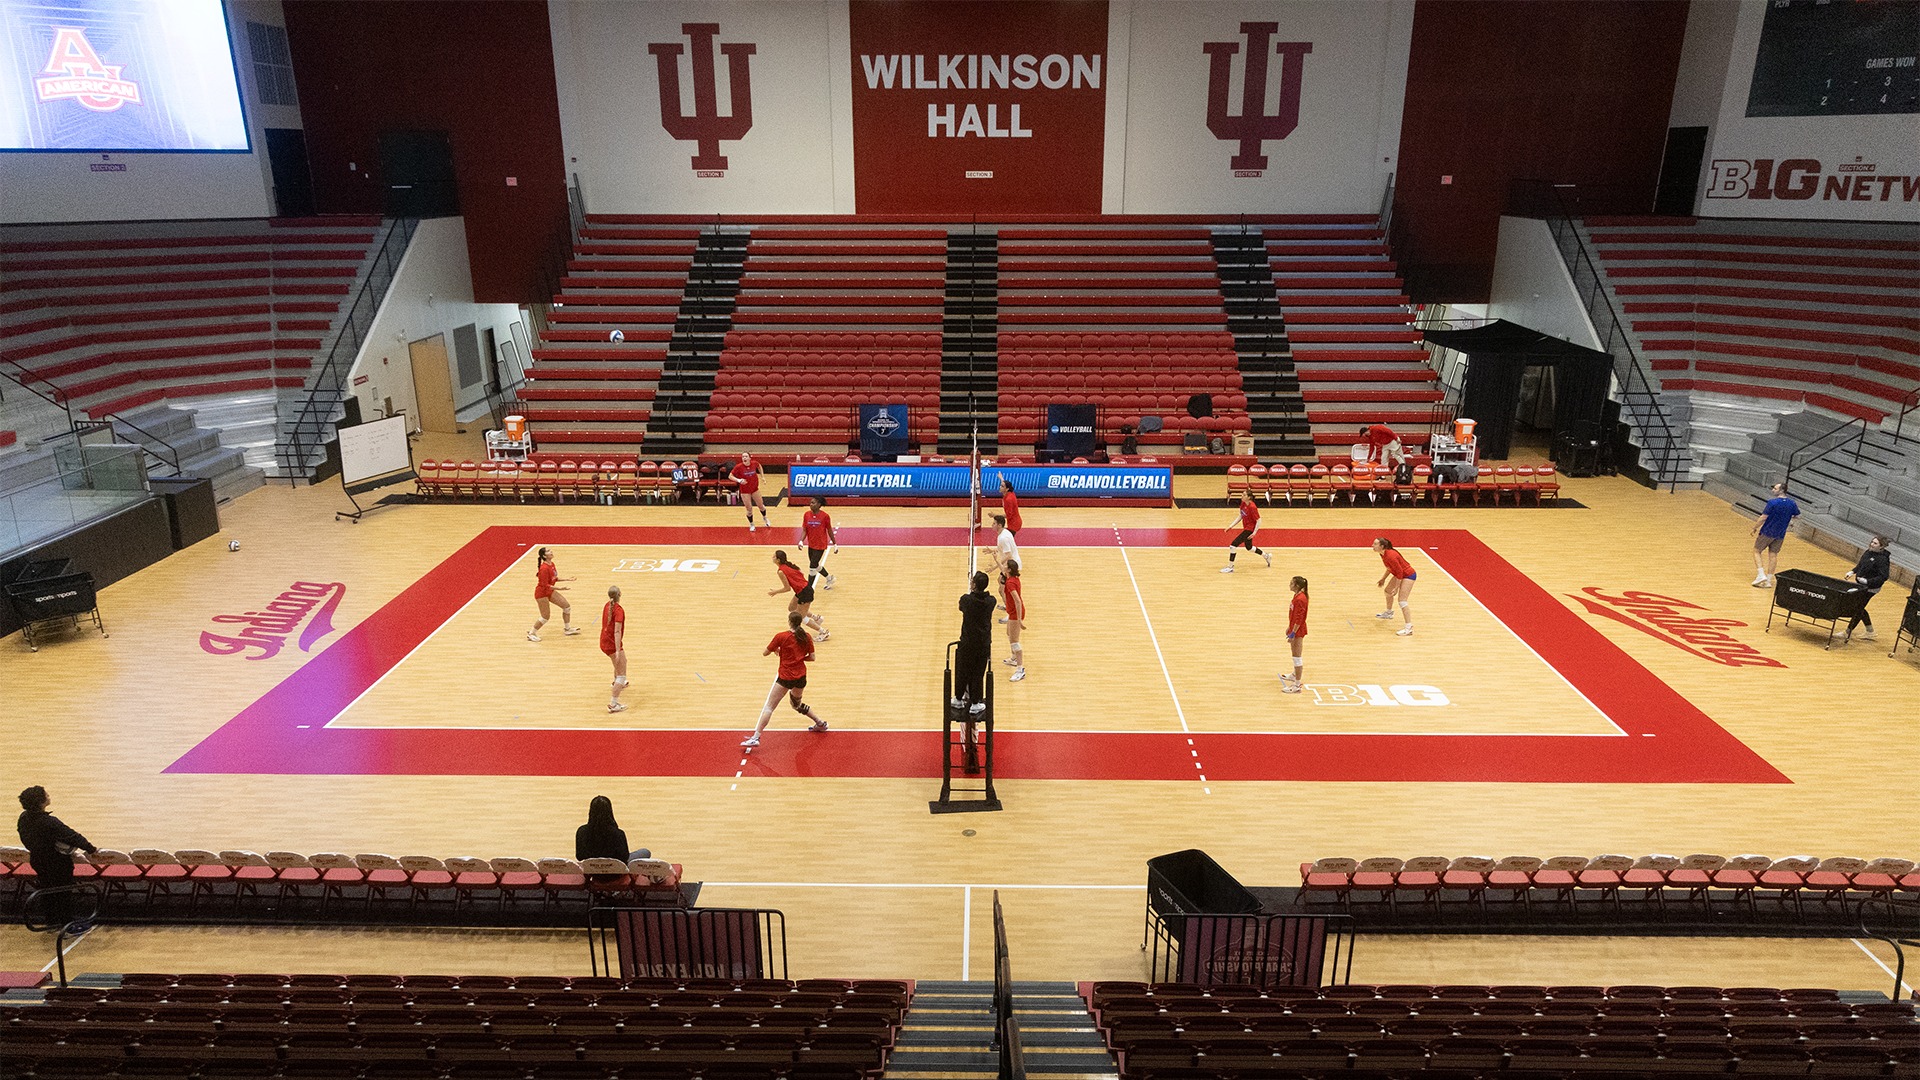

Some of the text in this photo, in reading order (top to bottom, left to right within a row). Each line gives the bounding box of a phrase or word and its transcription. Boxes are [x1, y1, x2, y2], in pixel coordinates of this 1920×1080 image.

[860, 54, 1101, 90] WILKINSON
[1866, 56, 1916, 68] GAMES WON
[44, 81, 134, 96] AMERICAN
[928, 104, 1032, 137] HALL
[794, 474, 912, 488] @NCAAVOLLEYBALL
[1048, 475, 1167, 489] @NCAAVOLLEYBALL
[199, 581, 346, 660] Indiana
[1562, 586, 1790, 667] Indiana
